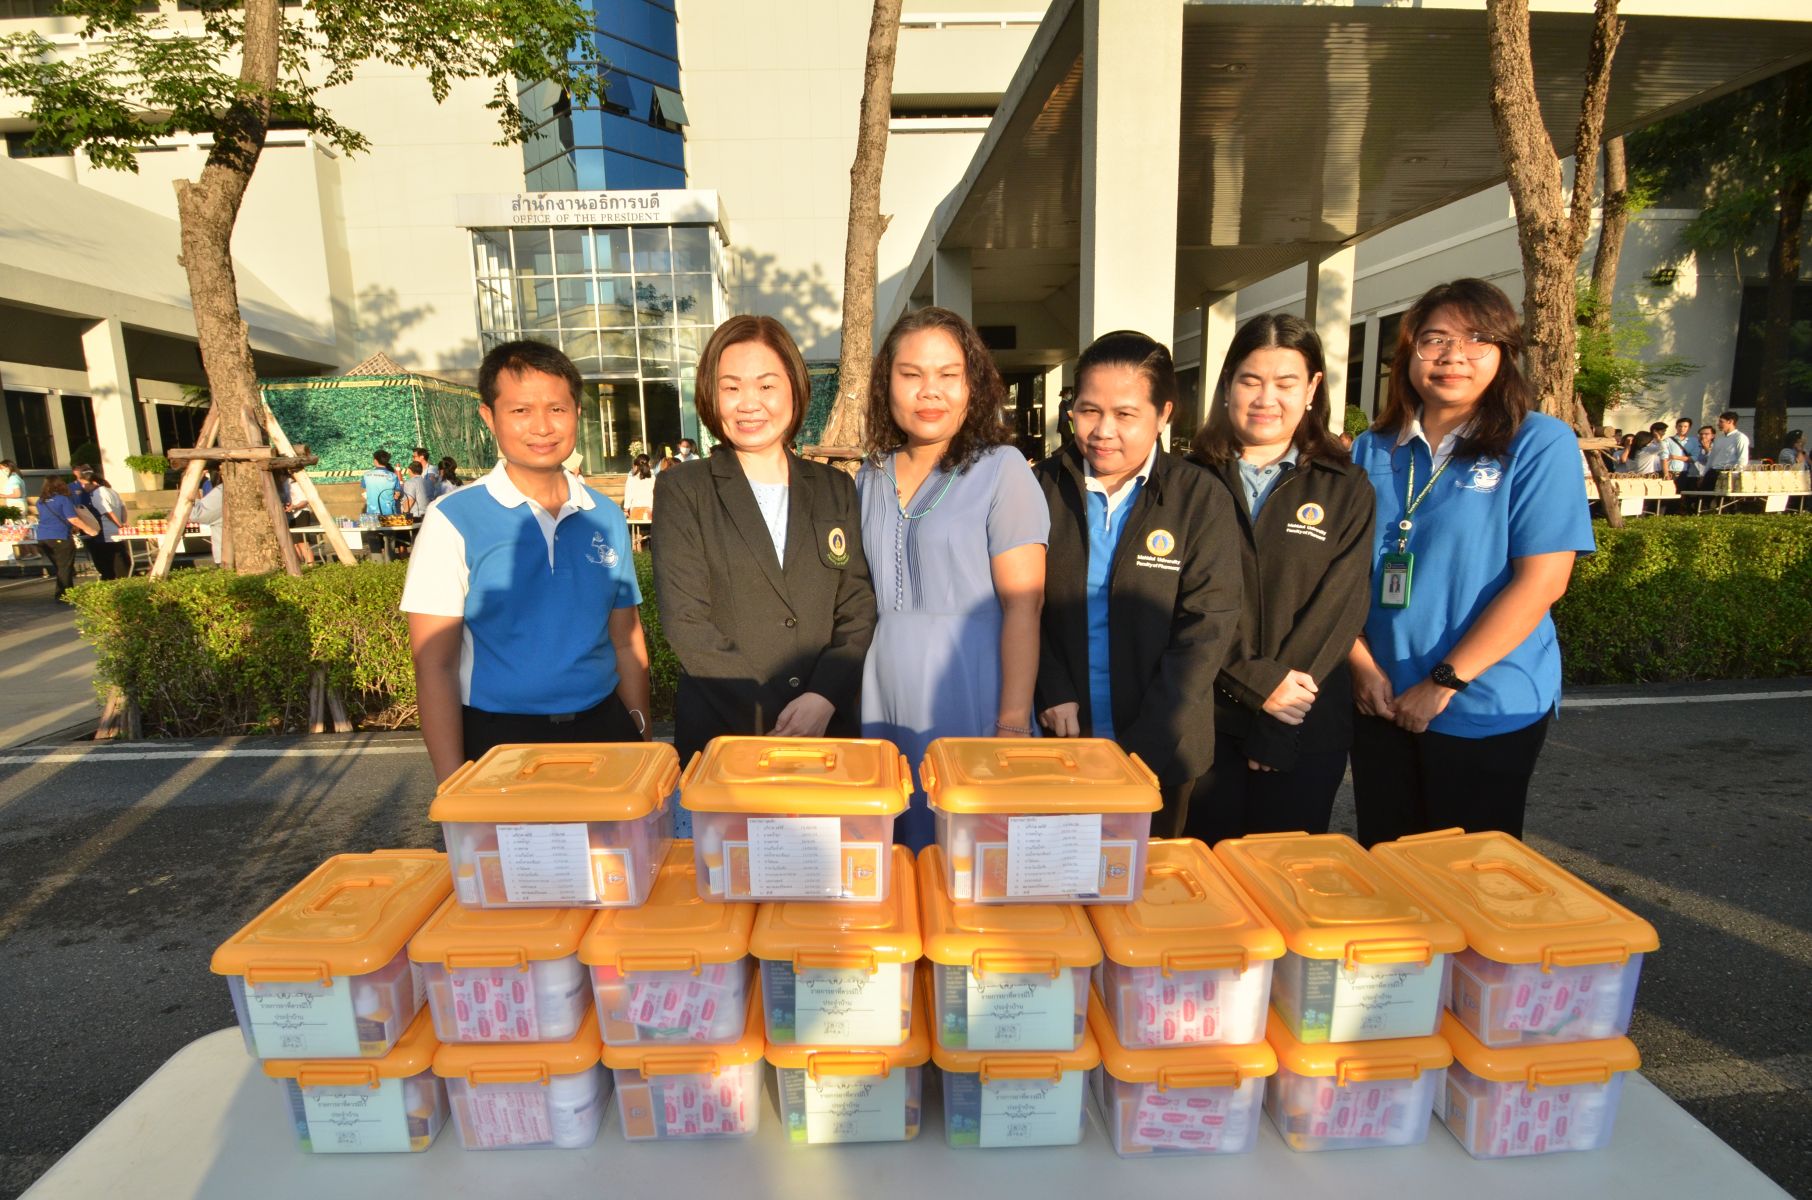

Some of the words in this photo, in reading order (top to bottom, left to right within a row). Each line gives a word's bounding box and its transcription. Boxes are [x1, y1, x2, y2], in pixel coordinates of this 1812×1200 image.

[511, 192, 660, 212] สำนักงานอธิการบดี
[513, 214, 550, 224] OFFICE
[556, 214, 570, 223] OF
[574, 214, 596, 222] THE
[600, 212, 660, 222] PRESIDENT
